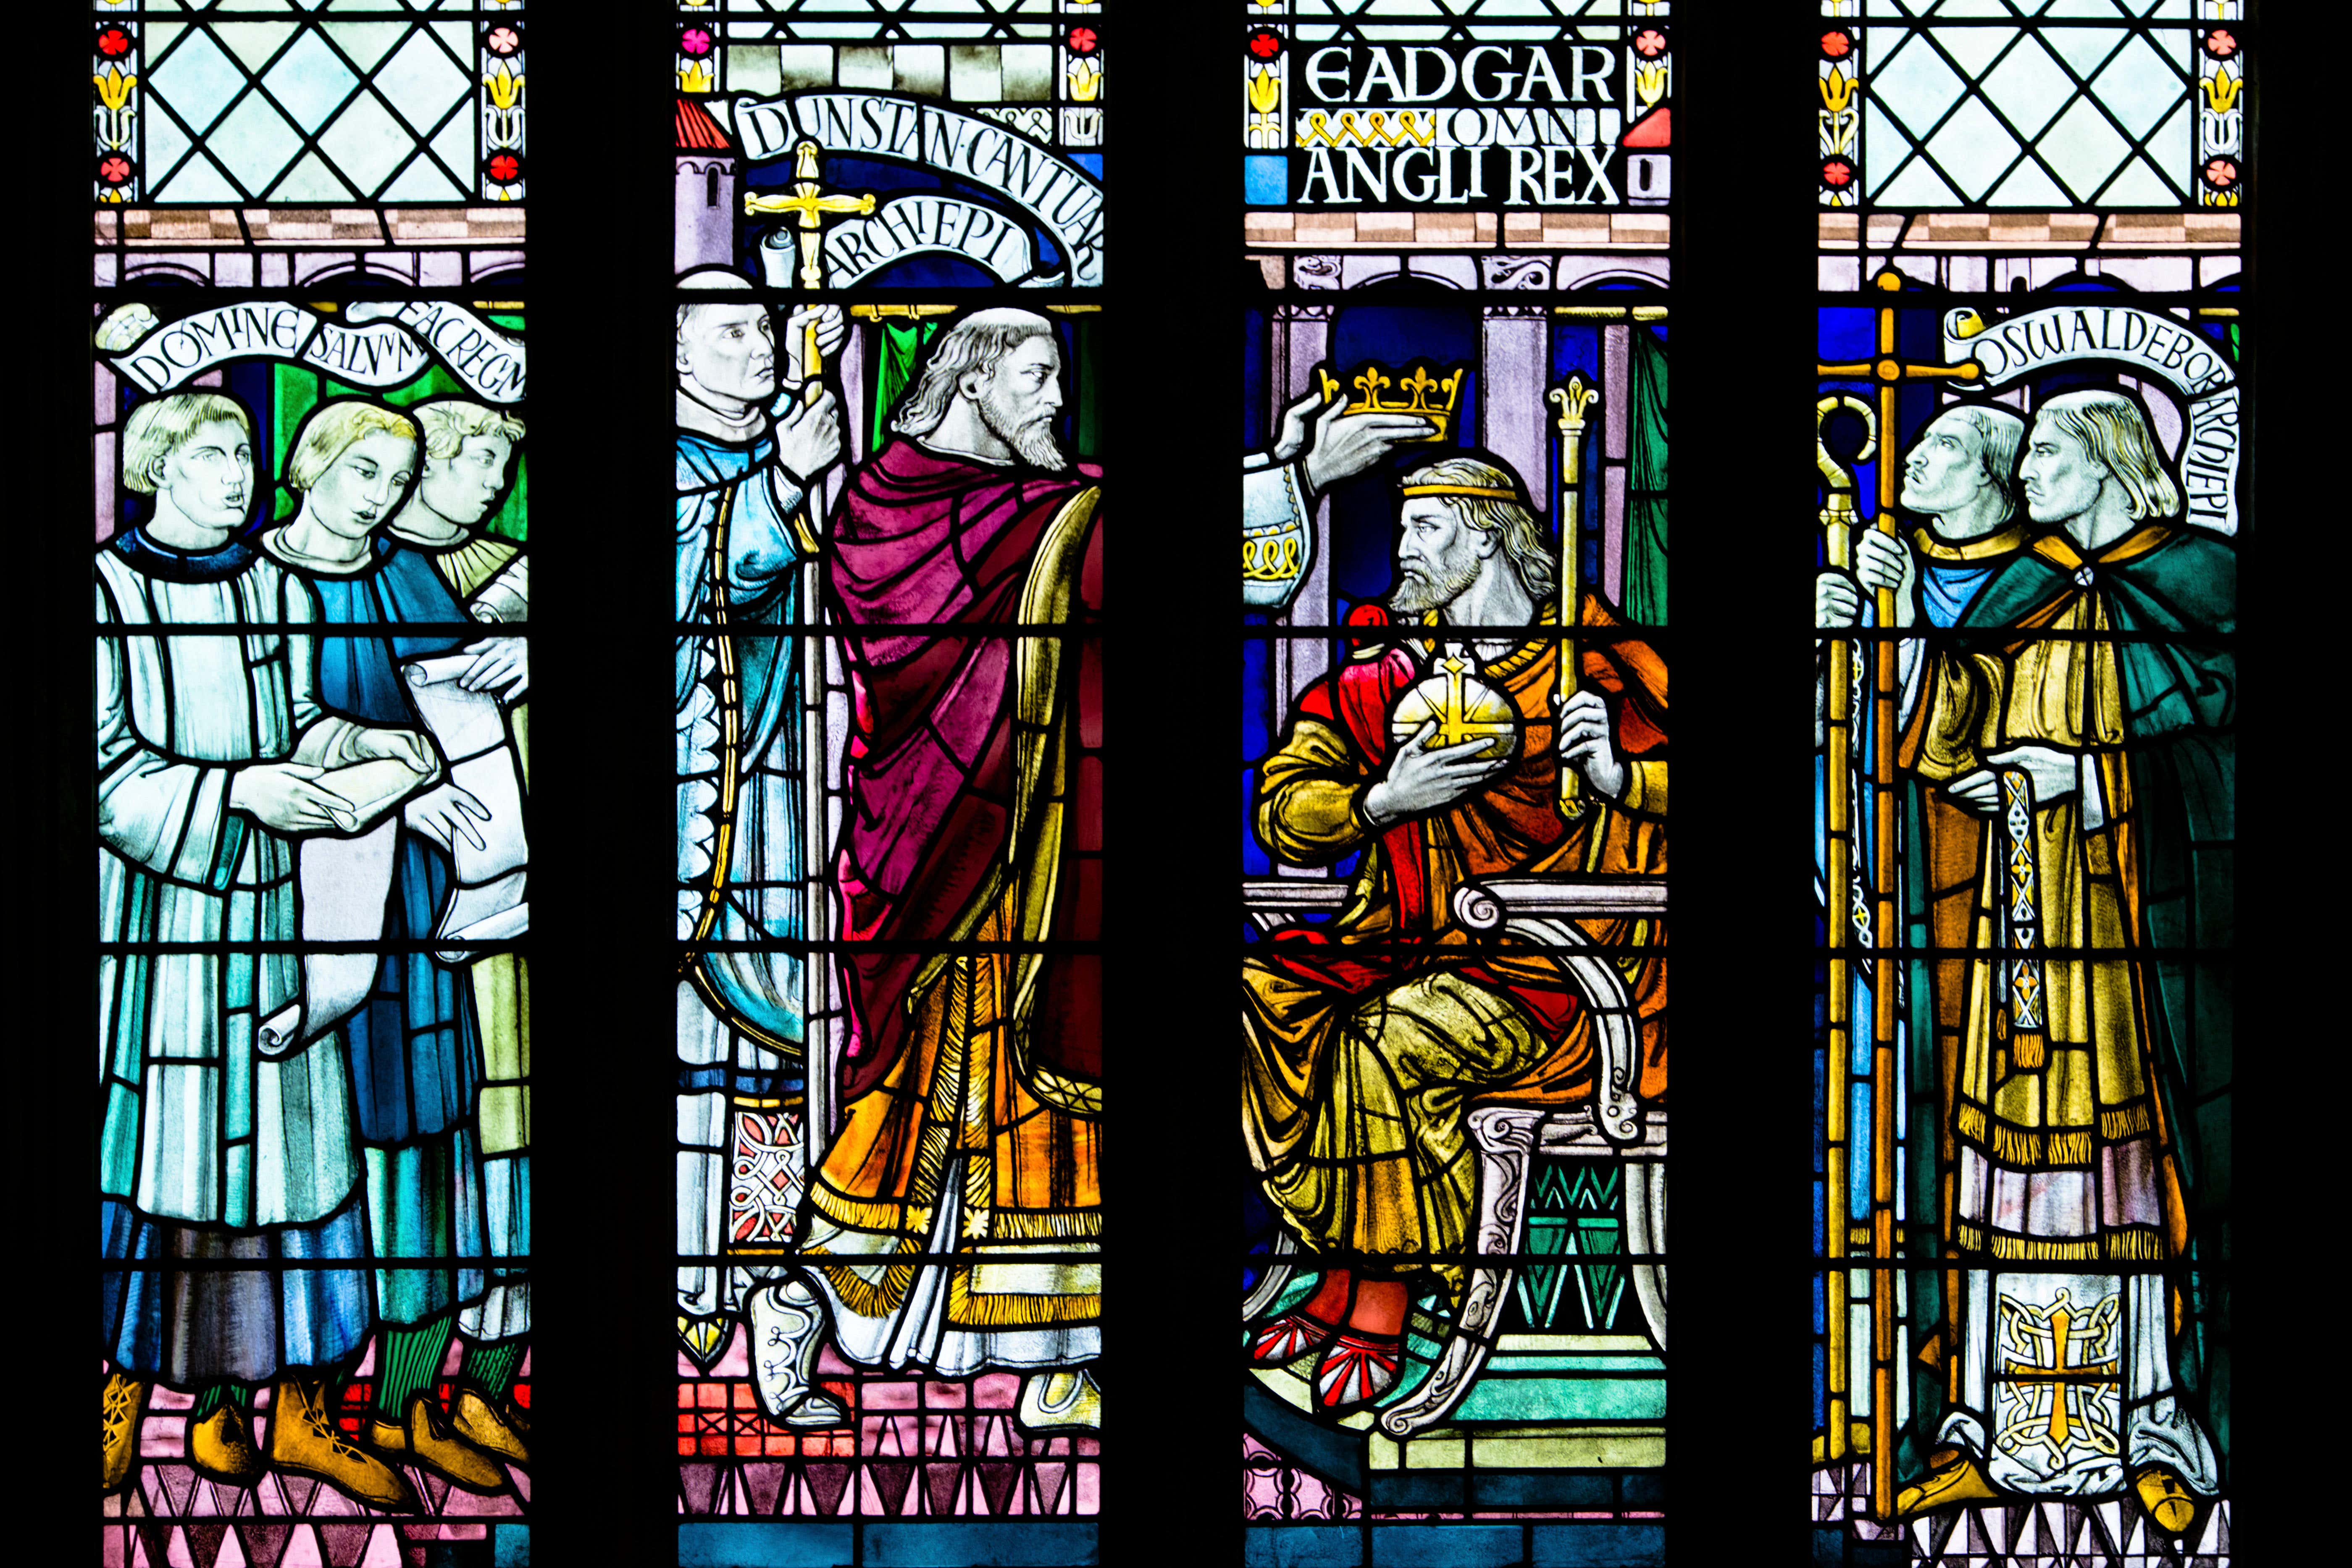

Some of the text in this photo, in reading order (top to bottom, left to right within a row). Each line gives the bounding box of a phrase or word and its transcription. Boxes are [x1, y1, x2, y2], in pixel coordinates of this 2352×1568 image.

[1305, 46, 1615, 102] EADGAR
[967, 127, 1104, 281] CANTUAR
[1297, 146, 1620, 205] ANGLI REX
[825, 200, 1016, 287] ARCHIEPI
[131, 308, 299, 391] DOMINE
[1974, 310, 2147, 375] OSWALD
[2141, 323, 2228, 394] EBOR
